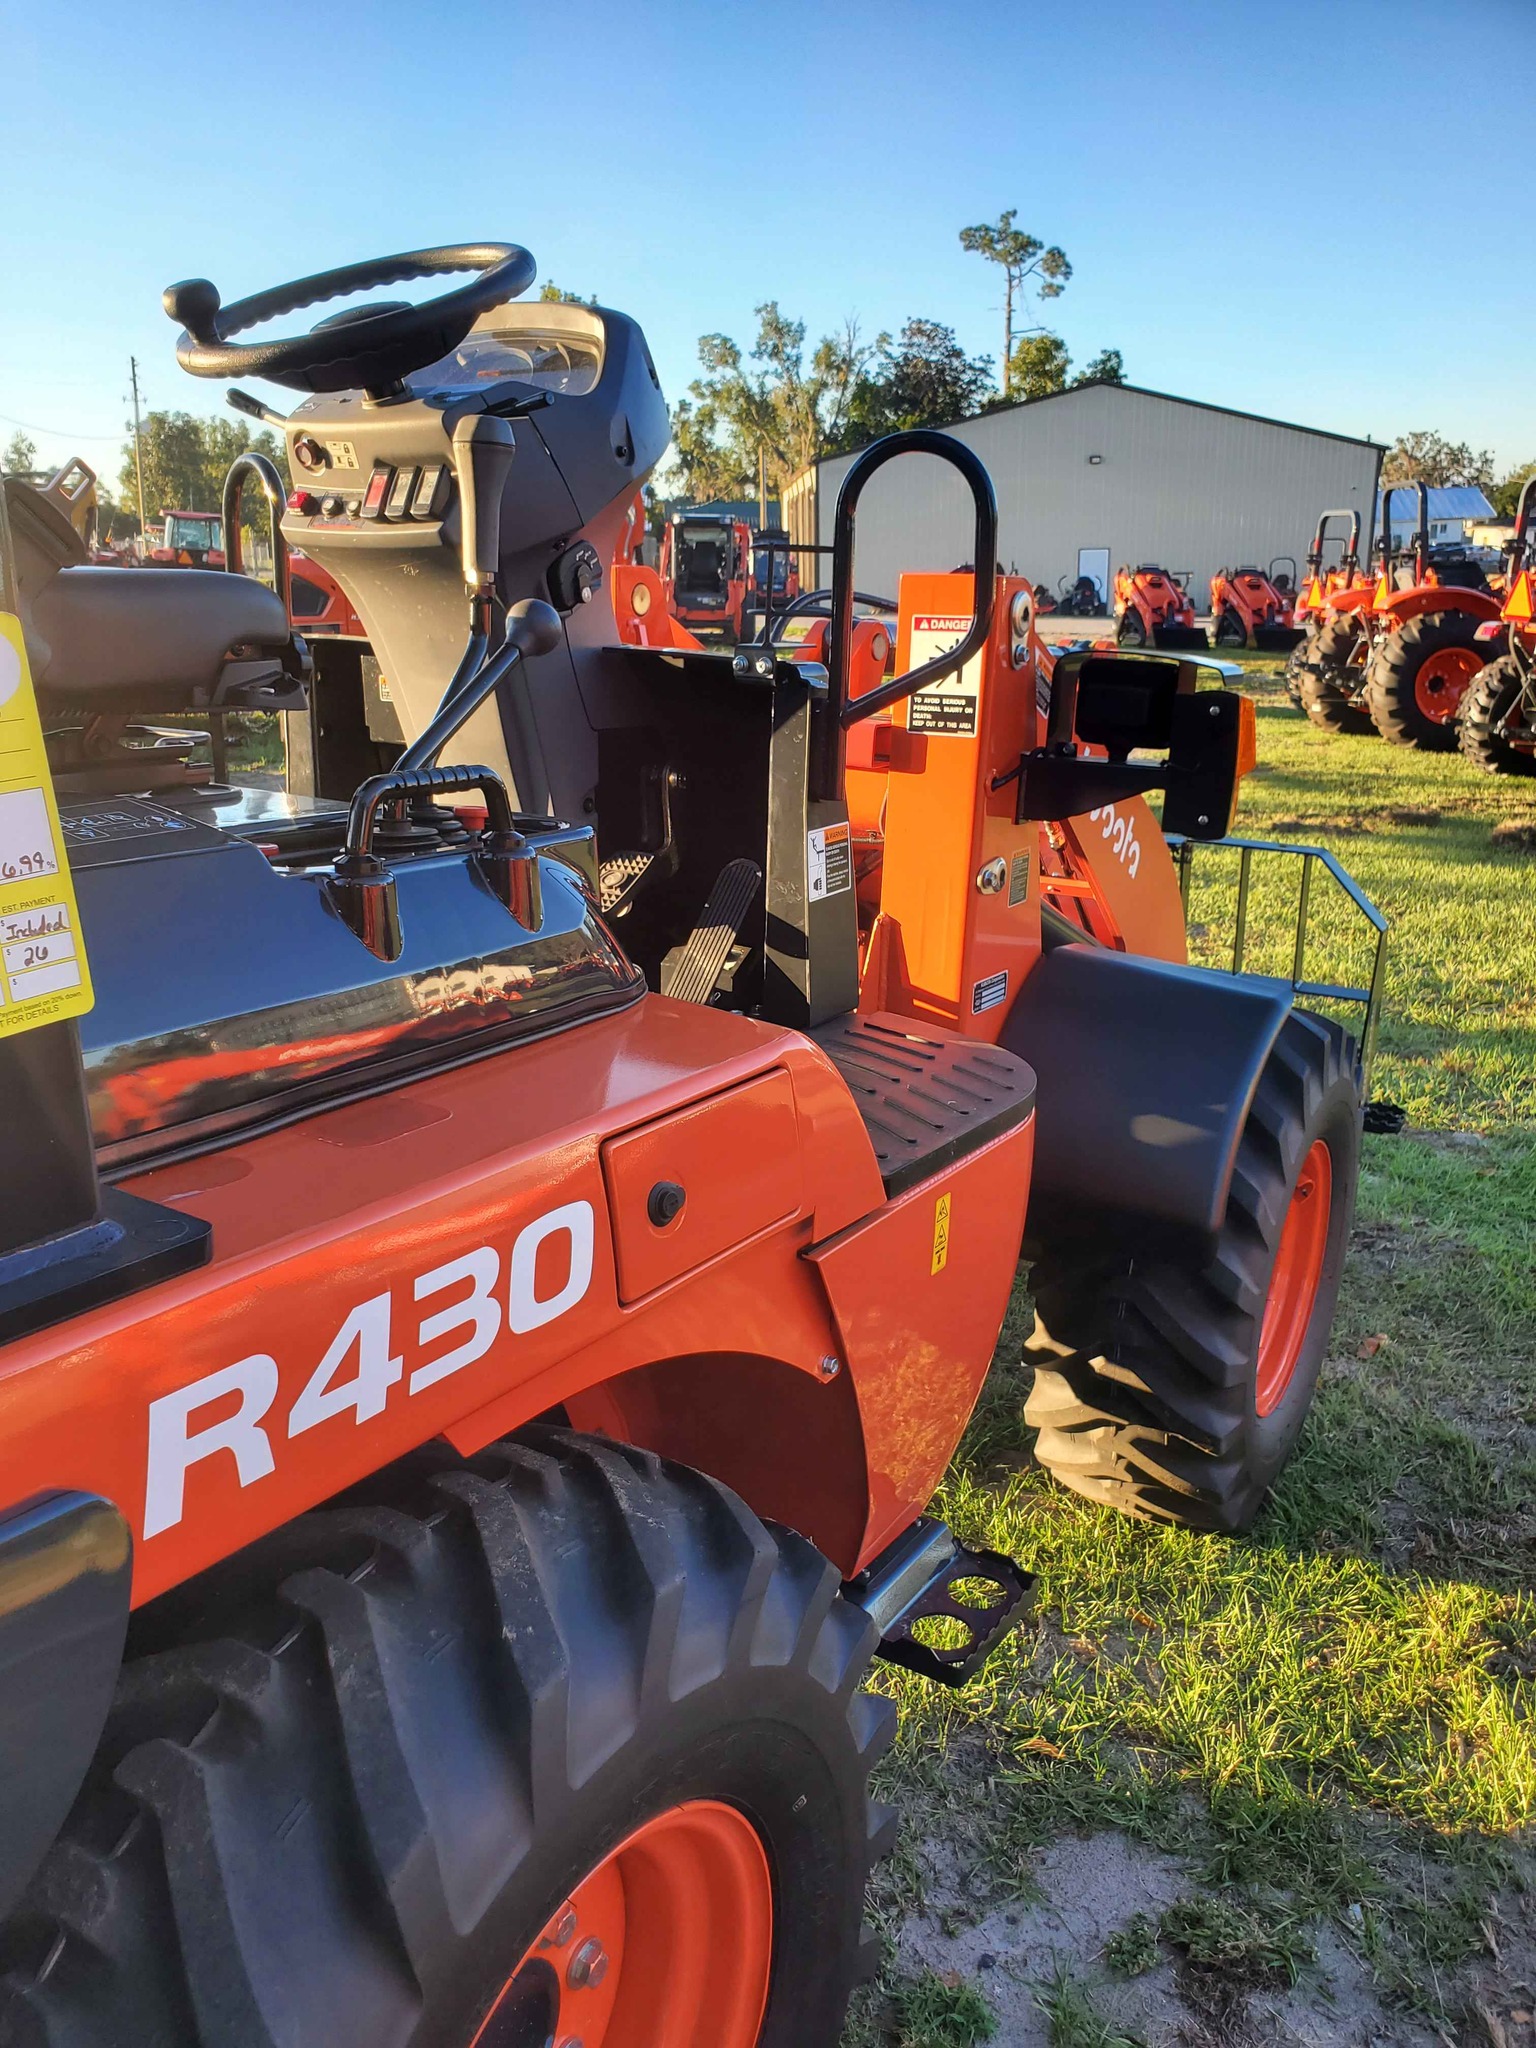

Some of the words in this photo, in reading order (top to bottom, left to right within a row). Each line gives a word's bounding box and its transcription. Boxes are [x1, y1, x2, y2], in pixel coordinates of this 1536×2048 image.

[942, 698, 966, 706] SERIOUS
[1, 904, 19, 914] EST.
[20, 895, 56, 909] PAYMENT
[6, 1014, 25, 1026] FOR
[25, 1004, 60, 1021] DETAILS
[143, 1200, 594, 1542] R430
